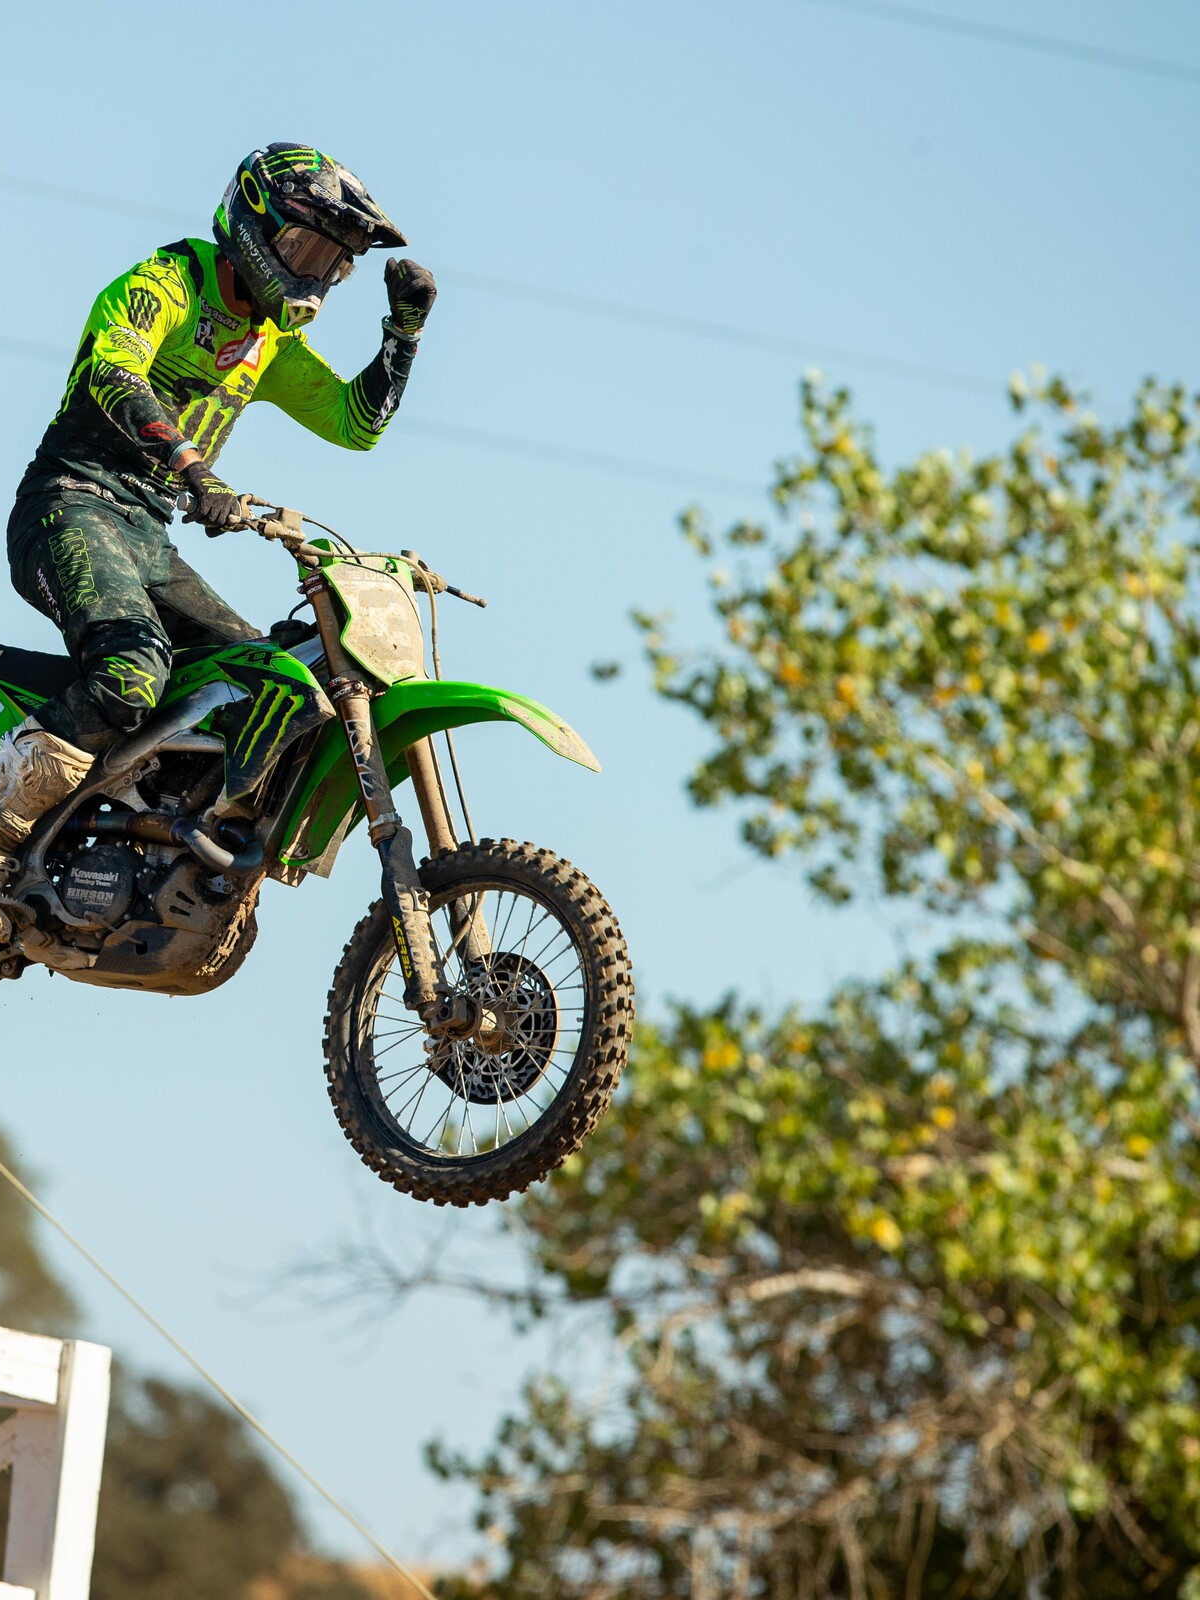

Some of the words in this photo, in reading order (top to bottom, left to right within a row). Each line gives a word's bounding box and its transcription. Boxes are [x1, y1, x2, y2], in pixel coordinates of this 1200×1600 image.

[237, 223, 273, 280] MONSTER
[71, 867, 119, 882] Kawasaki
[74, 877, 95, 886] Racing
[95, 879, 112, 888] Team
[67, 887, 114, 902] HINSON
[391, 915, 413, 979] ACERBIS
